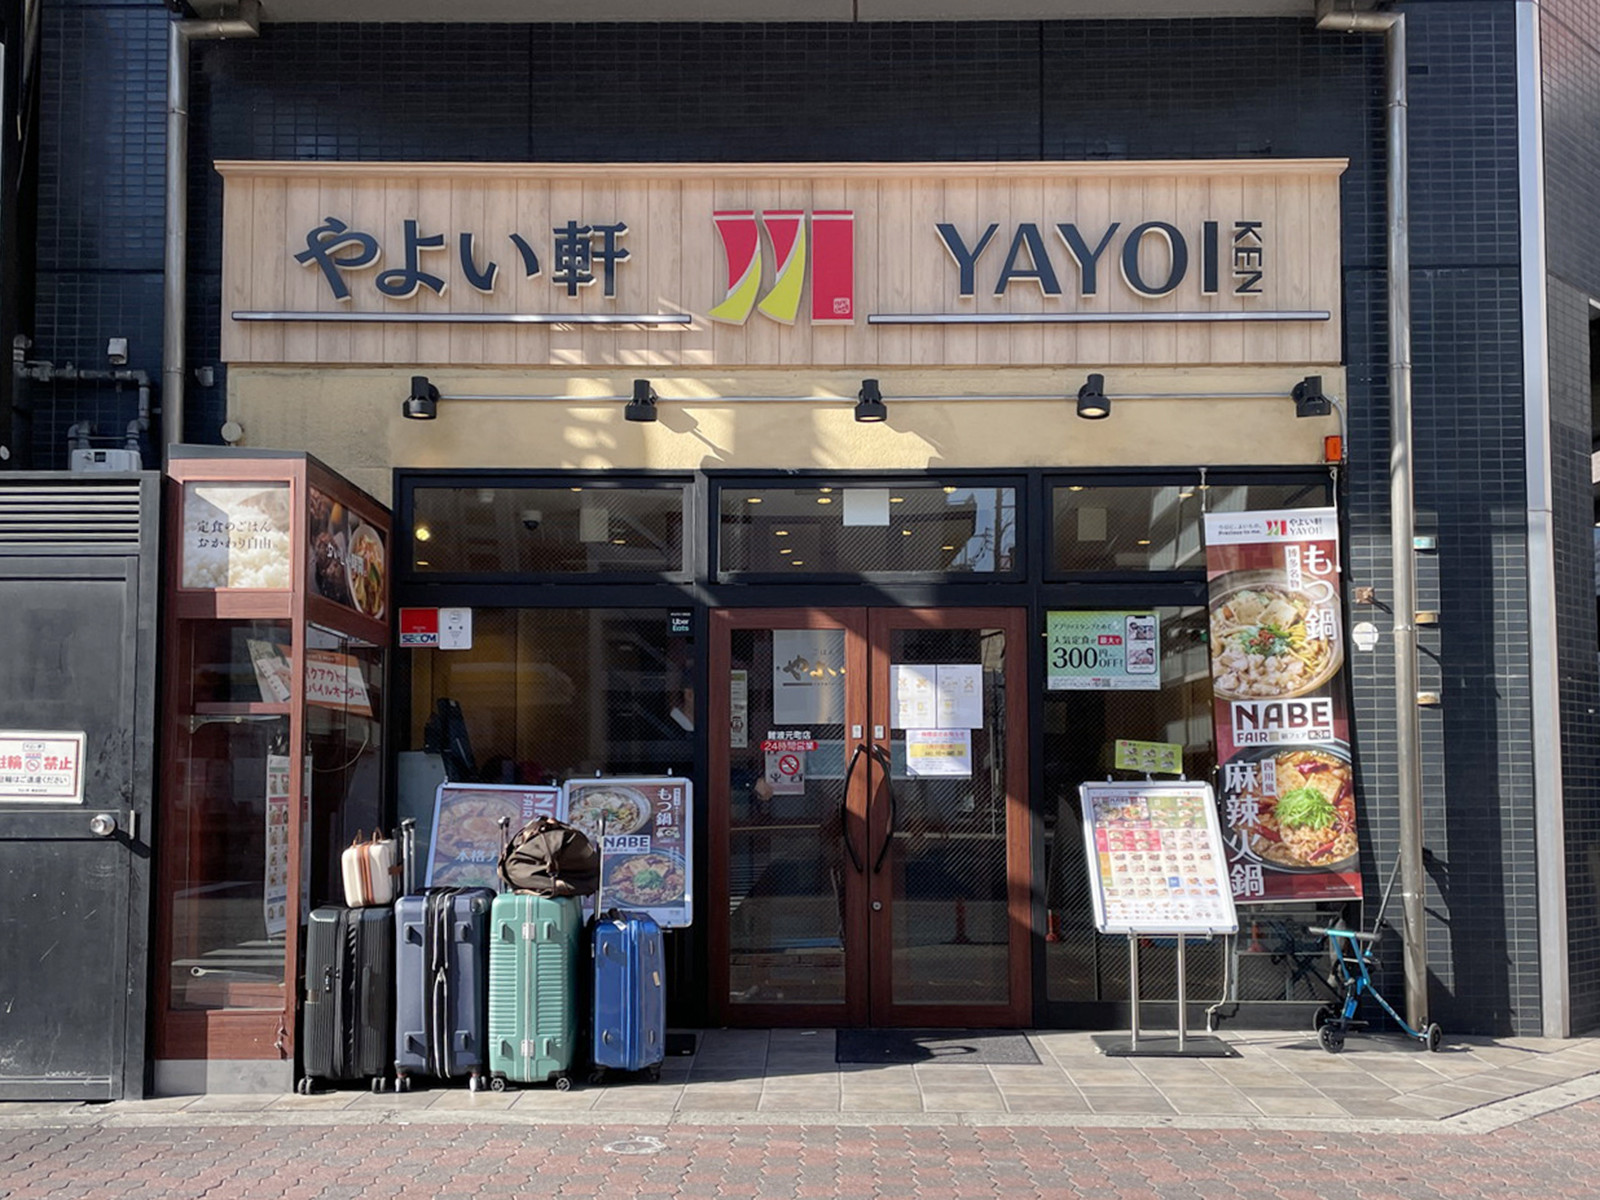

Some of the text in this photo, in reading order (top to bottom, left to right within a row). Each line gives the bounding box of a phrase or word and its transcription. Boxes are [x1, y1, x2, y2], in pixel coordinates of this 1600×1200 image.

[294, 216, 630, 301] やよい軒
[935, 221, 1219, 298] YAYOI
[1232, 221, 1264, 297] KEN
[197, 520, 272, 534] 定食のごはん
[1303, 545, 1337, 640] もつ鍋
[672, 617, 689, 625] Uber
[402, 634, 437, 643] SECOM
[1052, 647, 1098, 669] 300
[1235, 702, 1330, 730] NABE
[764, 740, 814, 751] 24時間営業
[1236, 732, 1268, 743] FAIR
[44, 756, 73, 770] 禁止
[523, 793, 534, 817] FAIR
[656, 788, 672, 826] もつ鍋
[1224, 760, 1265, 896] 麻辣火鍋
[604, 836, 649, 848] NABE
